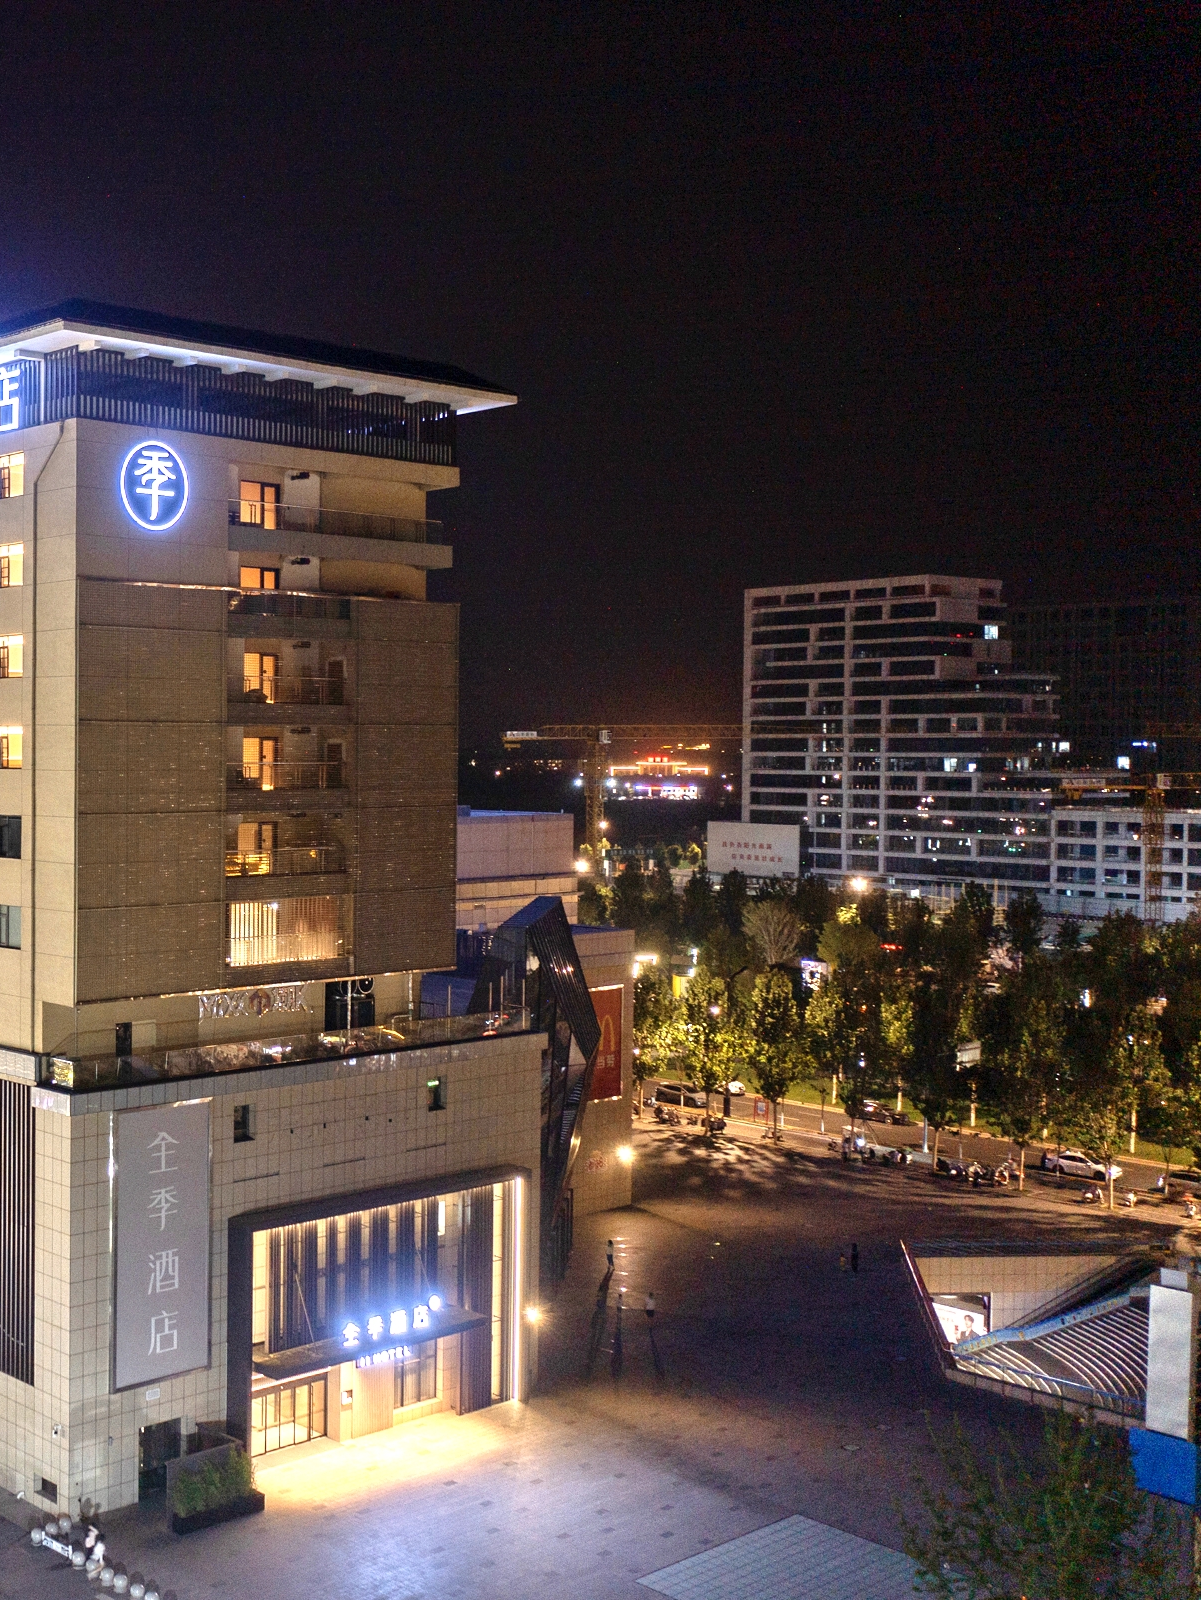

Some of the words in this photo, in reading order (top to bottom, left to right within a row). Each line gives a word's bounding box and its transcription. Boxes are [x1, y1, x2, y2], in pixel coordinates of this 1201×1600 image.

[134, 450, 177, 521] 季
[146, 1131, 179, 1357] 全季酒店
